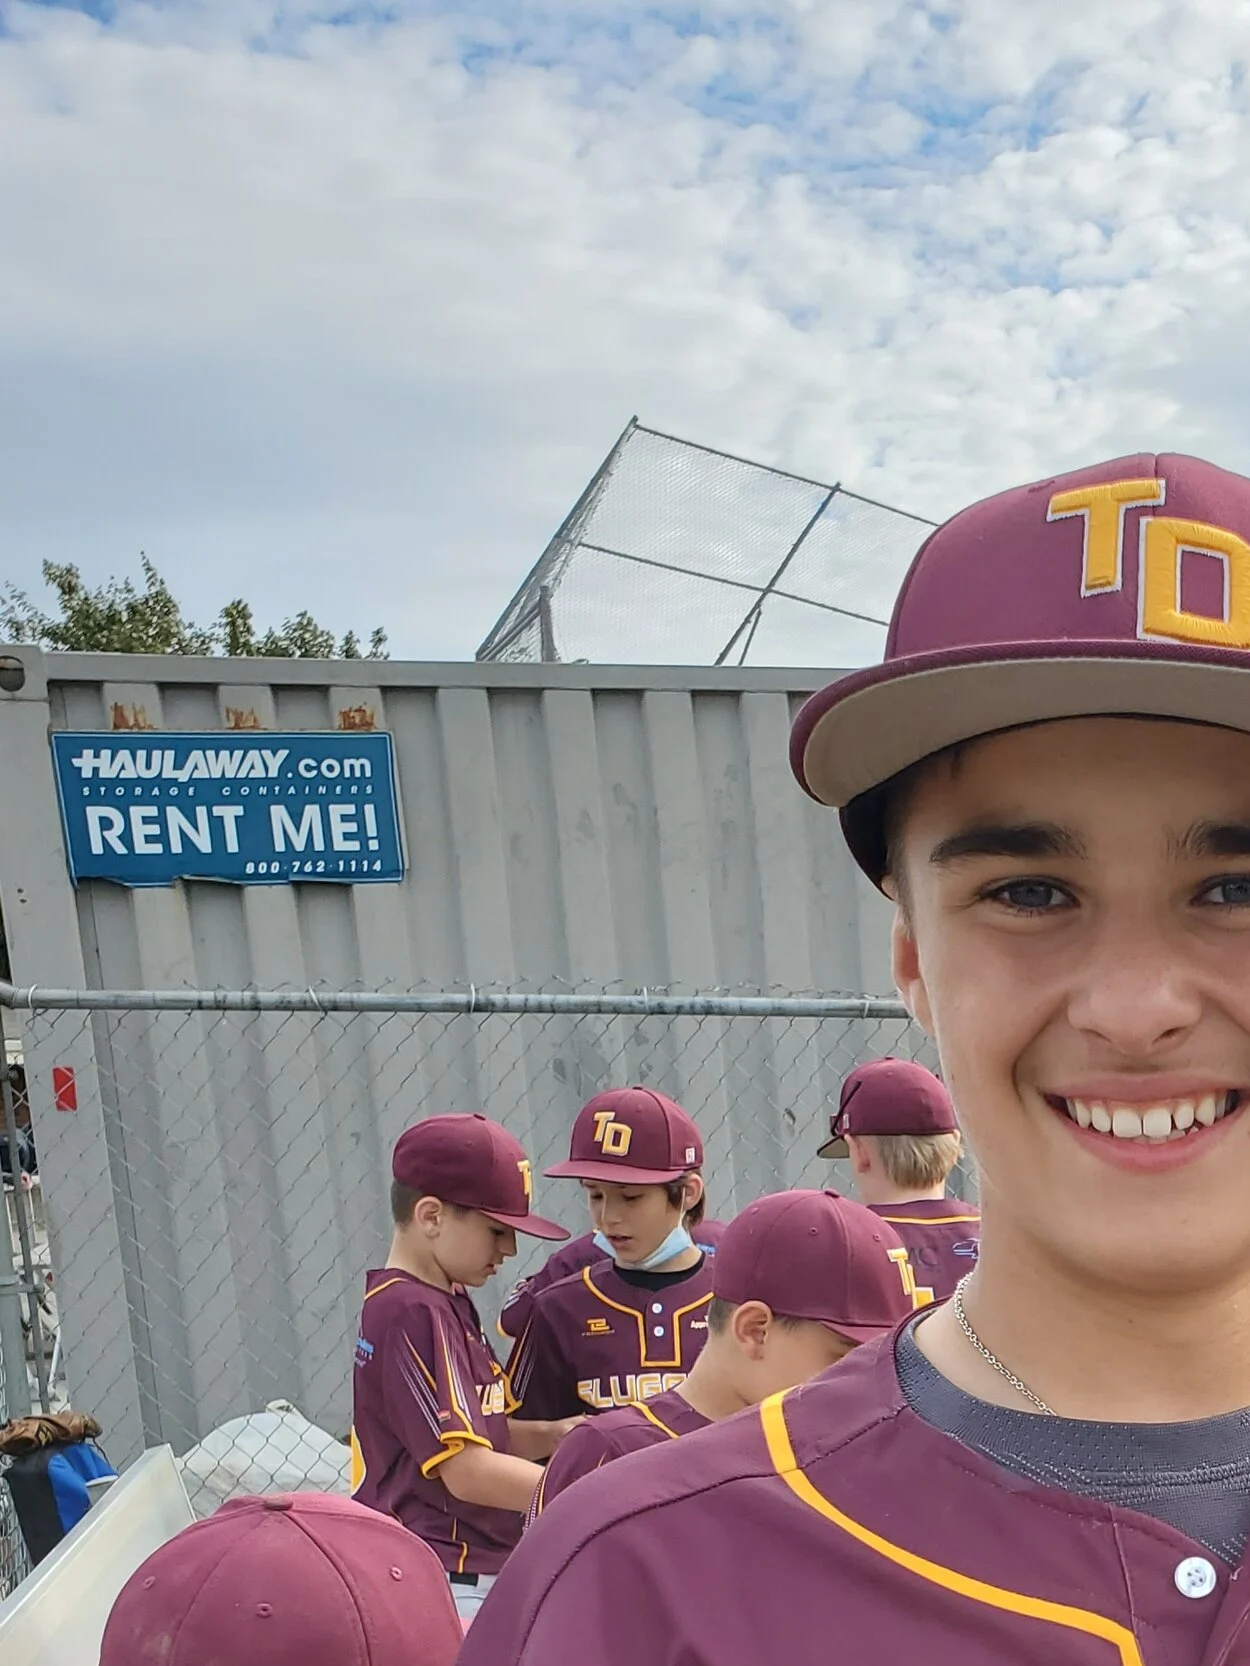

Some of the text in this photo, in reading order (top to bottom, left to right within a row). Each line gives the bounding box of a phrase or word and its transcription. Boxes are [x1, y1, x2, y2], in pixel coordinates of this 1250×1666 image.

[72, 749, 372, 782] HAULAWAY.com
[82, 784, 374, 797] STORAGE CONTAINERS
[85, 803, 381, 855] RENT ME!
[594, 1111, 633, 1157] TD
